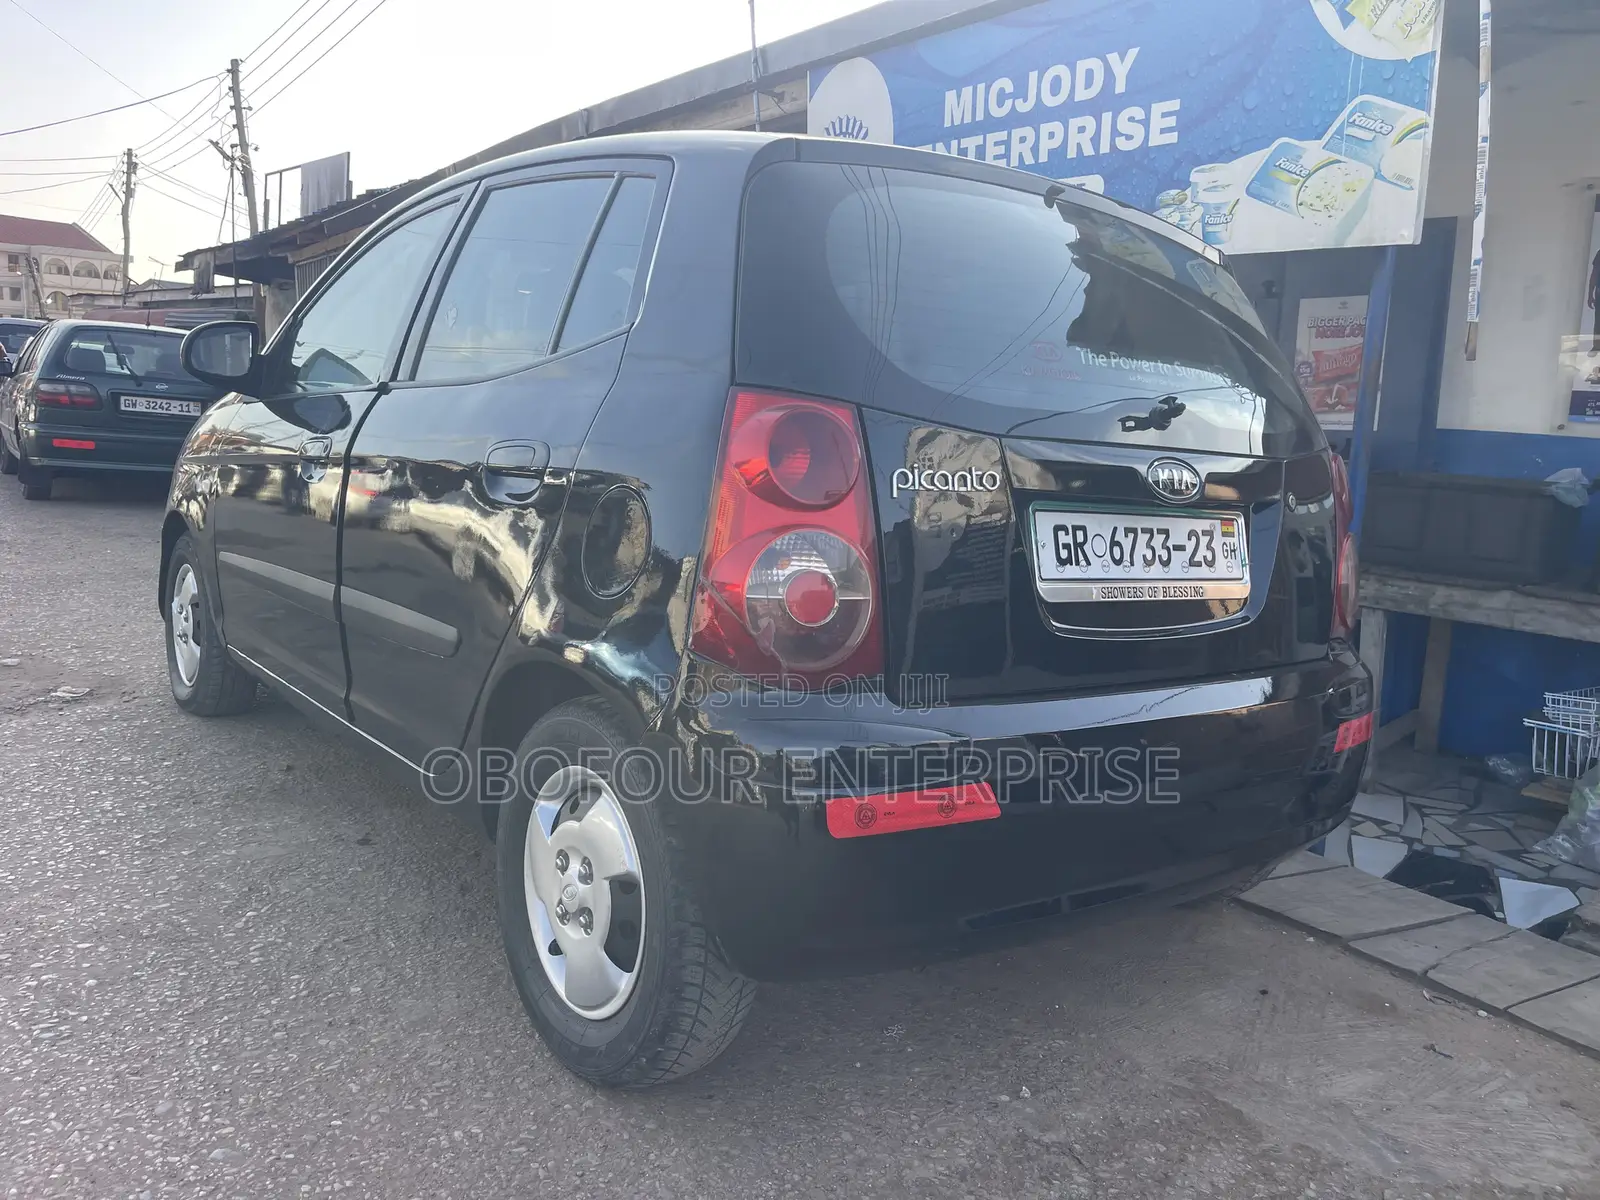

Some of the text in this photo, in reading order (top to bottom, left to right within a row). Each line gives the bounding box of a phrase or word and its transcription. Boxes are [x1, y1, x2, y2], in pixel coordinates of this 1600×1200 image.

[943, 47, 1141, 128] MICJODY
[915, 99, 1181, 168] TERPRISE
[1347, 112, 1394, 136] FanIce
[1274, 156, 1311, 179] FanIce
[1204, 213, 1234, 225] FanIce
[1307, 317, 1346, 328] BIGGER
[1076, 347, 1108, 367] The
[1110, 351, 1156, 373] Power
[123, 398, 192, 413] GW 3242-11
[892, 463, 1001, 498] picanto
[1156, 467, 1194, 491] KIA
[1052, 524, 1216, 567] GR 6733-23
[1221, 541, 1238, 561] GH
[1100, 585, 1204, 599] SHOWERS OF BLESSING
